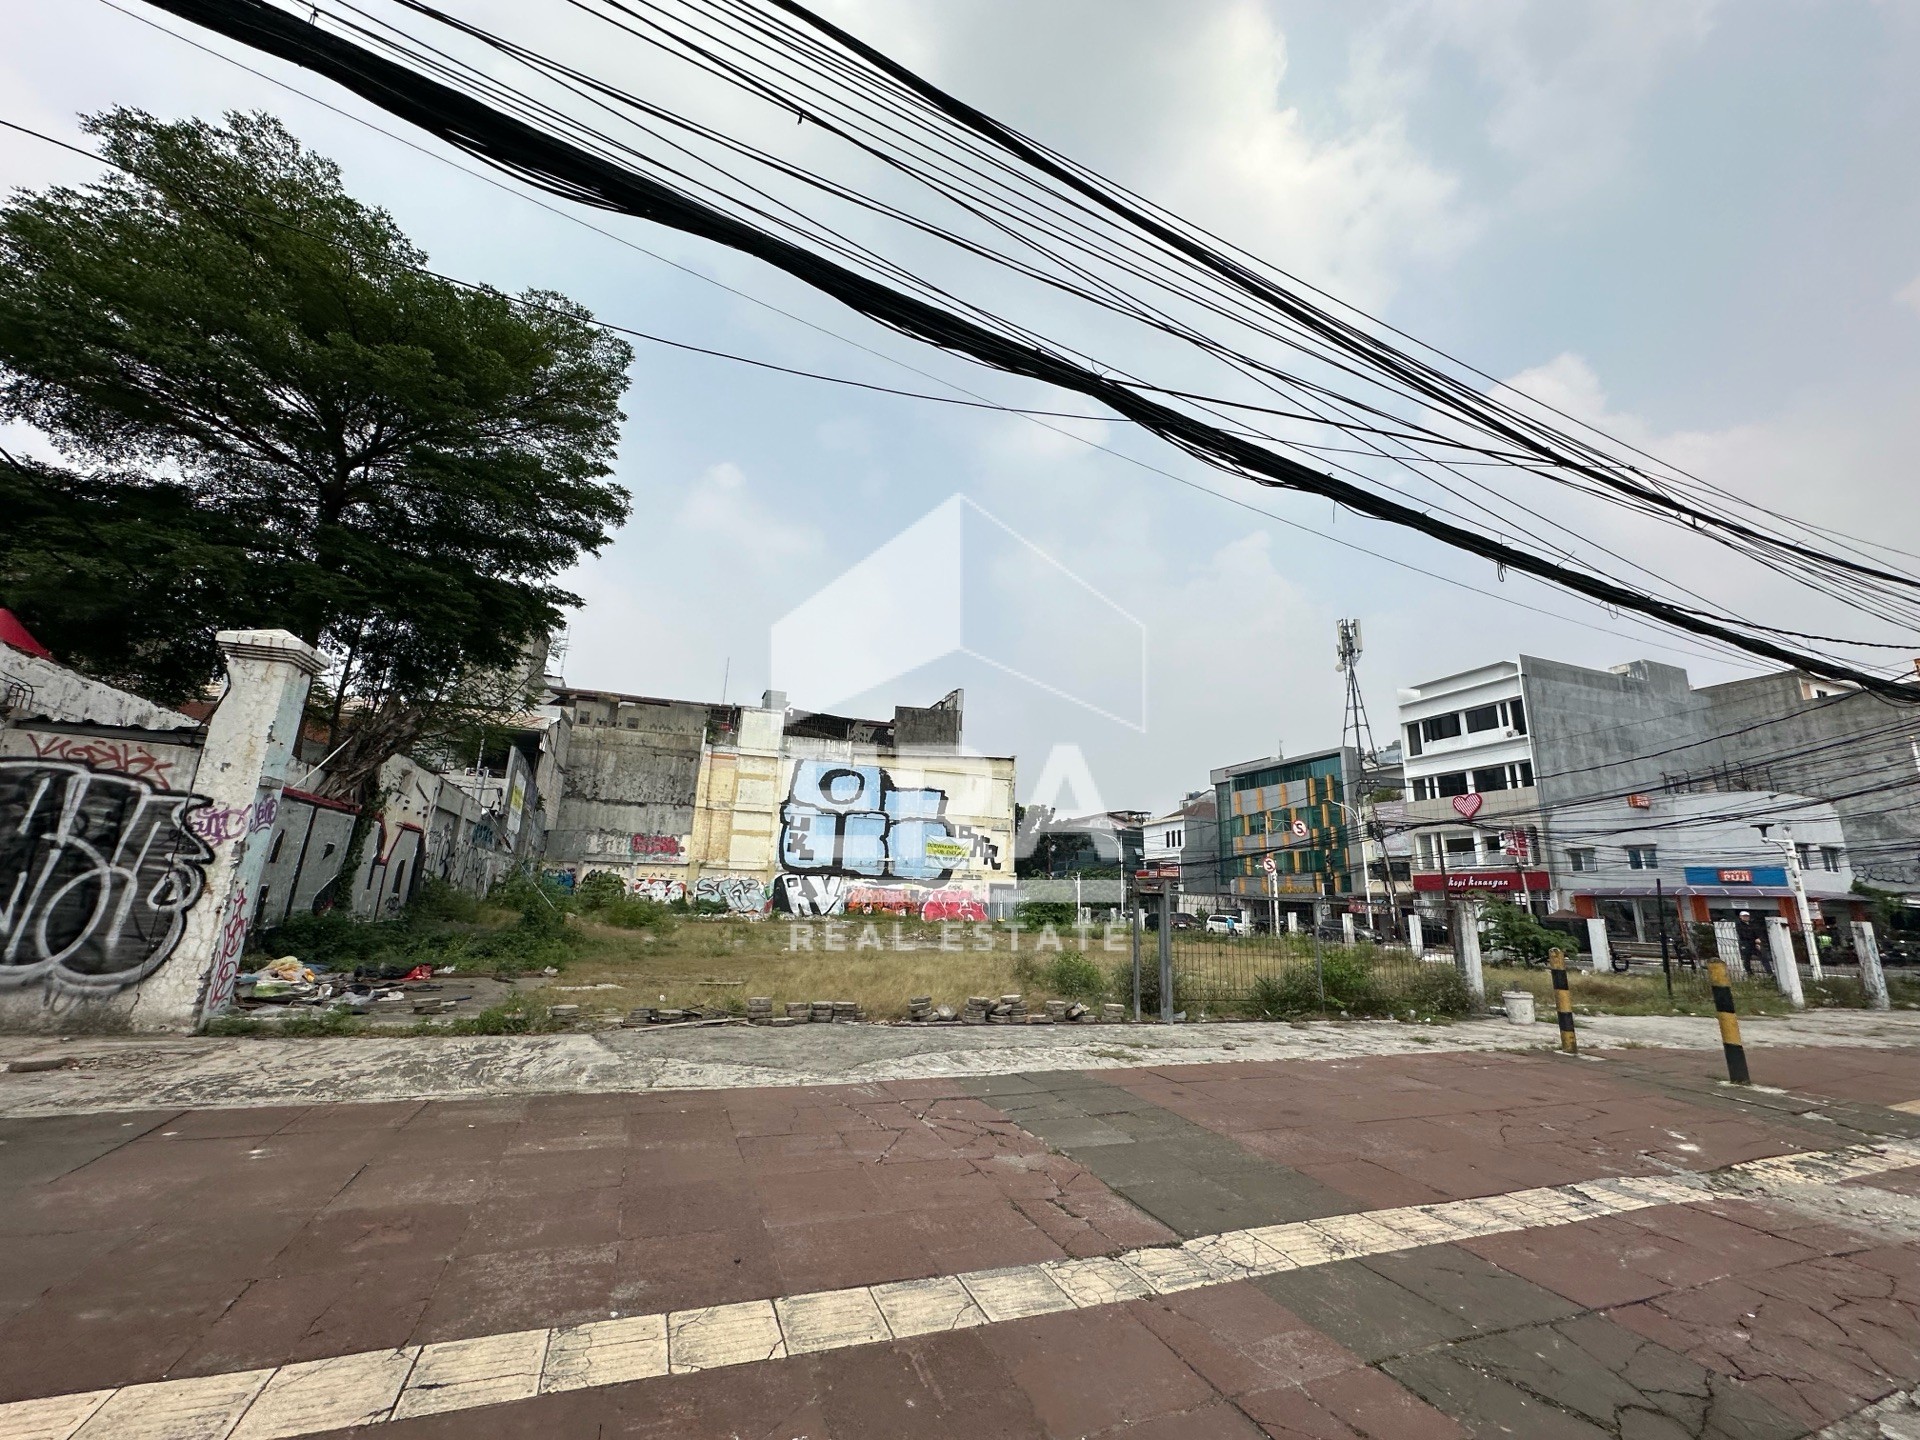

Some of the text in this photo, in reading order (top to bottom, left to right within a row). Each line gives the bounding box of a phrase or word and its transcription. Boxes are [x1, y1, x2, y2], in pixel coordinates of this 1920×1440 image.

[1448, 875, 1509, 889] kopi kenangan
[1724, 874, 1750, 882] PUJI
